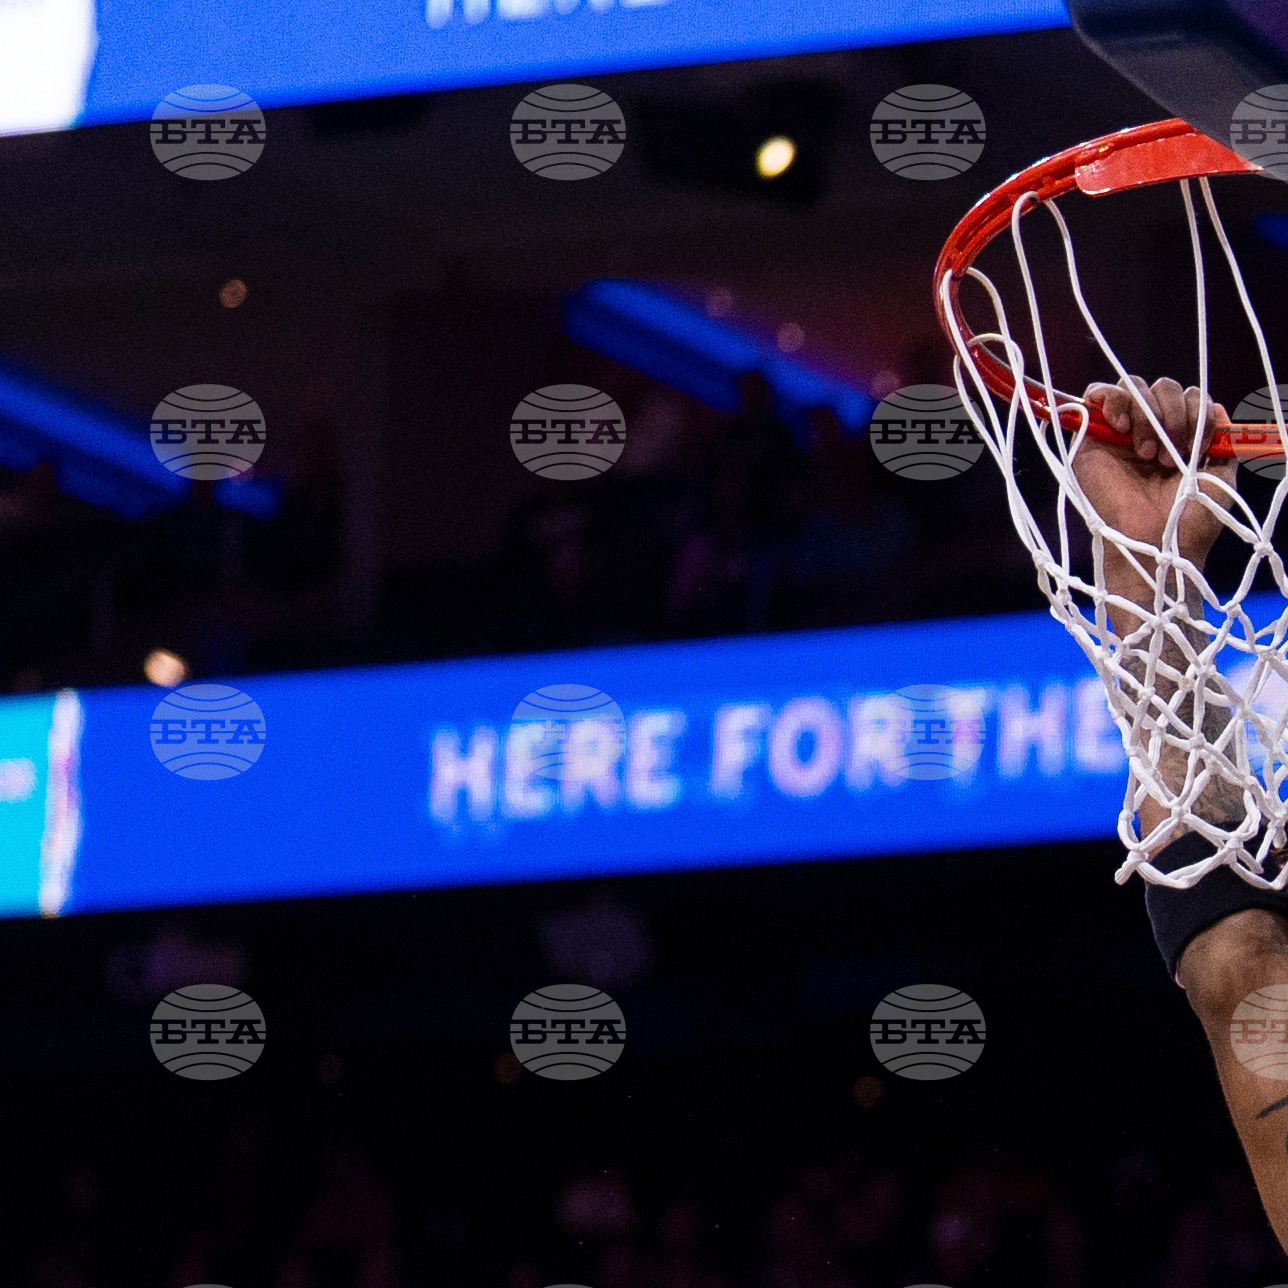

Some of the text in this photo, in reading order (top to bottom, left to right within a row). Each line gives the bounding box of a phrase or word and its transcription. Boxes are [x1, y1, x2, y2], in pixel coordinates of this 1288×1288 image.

[428, 709, 687, 822] HERE
[710, 692, 914, 799] FOR
[937, 677, 1127, 788] THE
